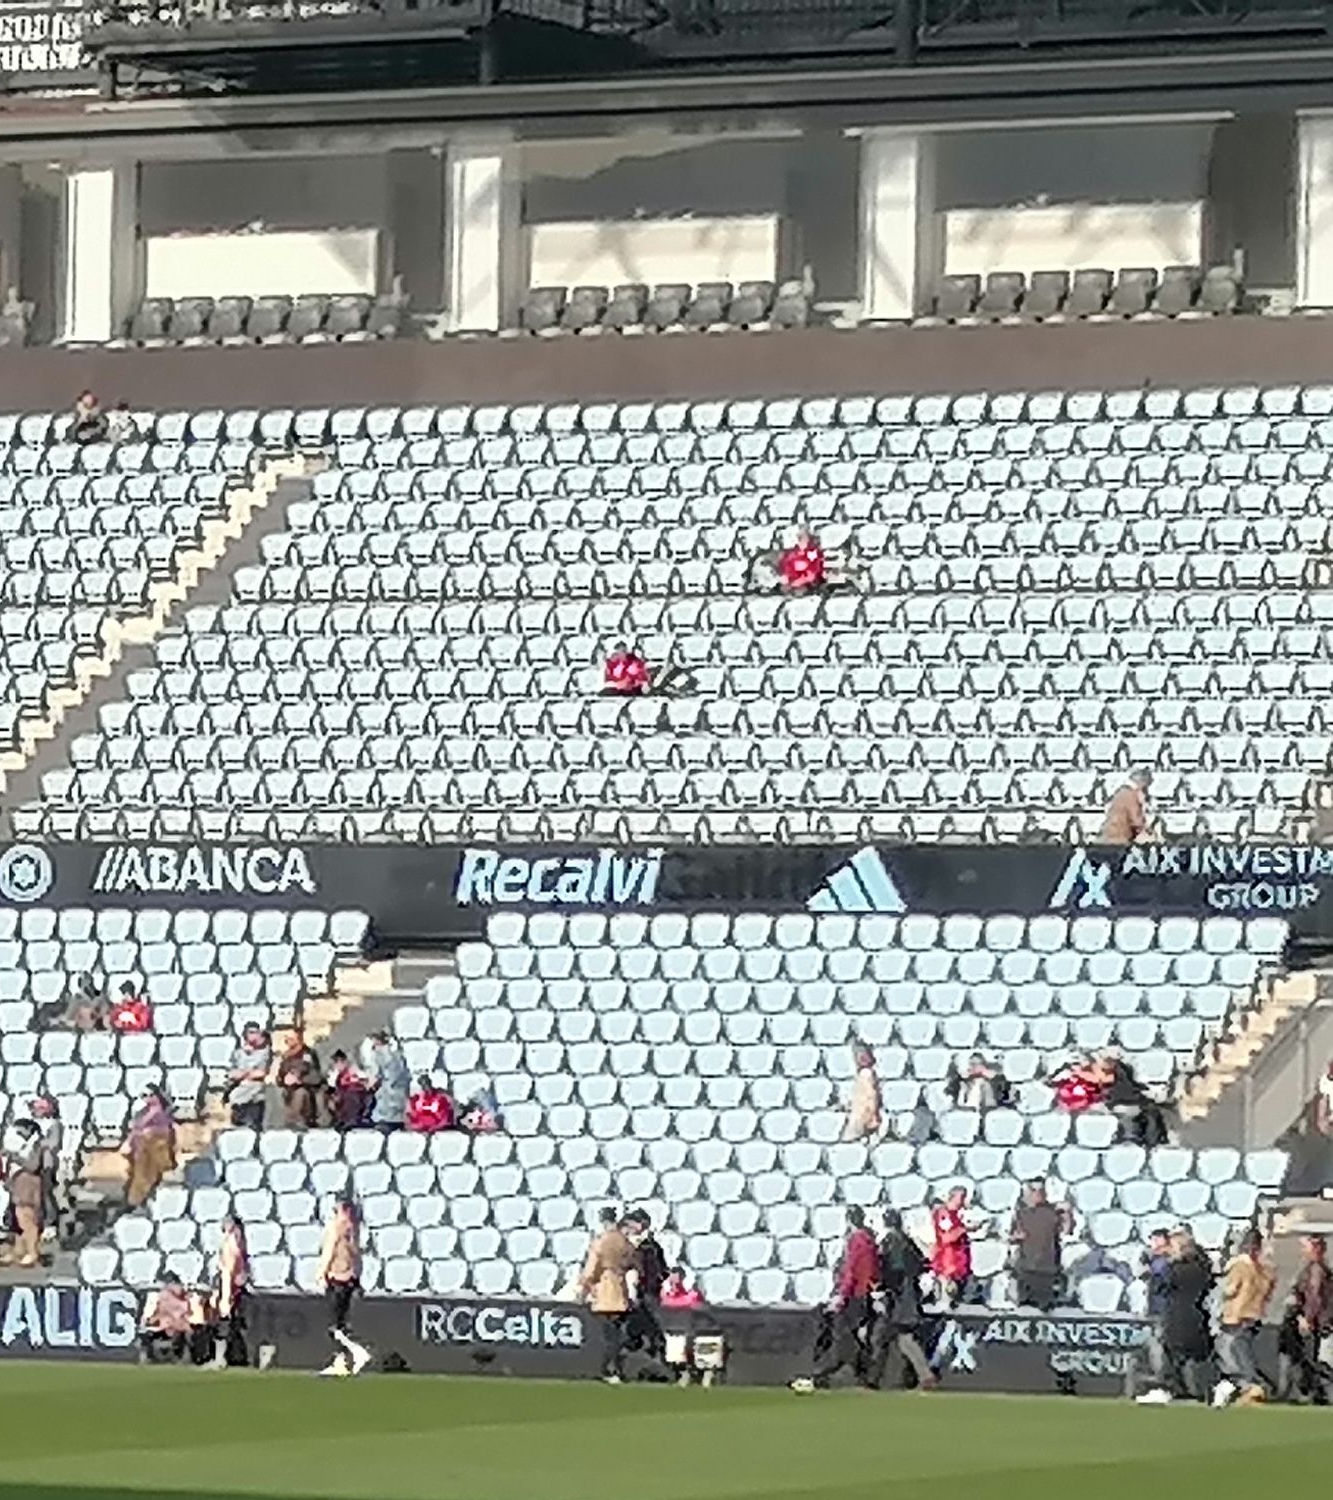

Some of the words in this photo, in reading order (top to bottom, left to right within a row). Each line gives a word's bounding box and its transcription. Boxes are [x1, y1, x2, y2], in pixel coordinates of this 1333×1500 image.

[1123, 847, 1183, 874] AIX
[1190, 846, 1333, 875] INVESTM
[456, 848, 664, 904] Recalvi
[1207, 883, 1320, 910] GROUP
